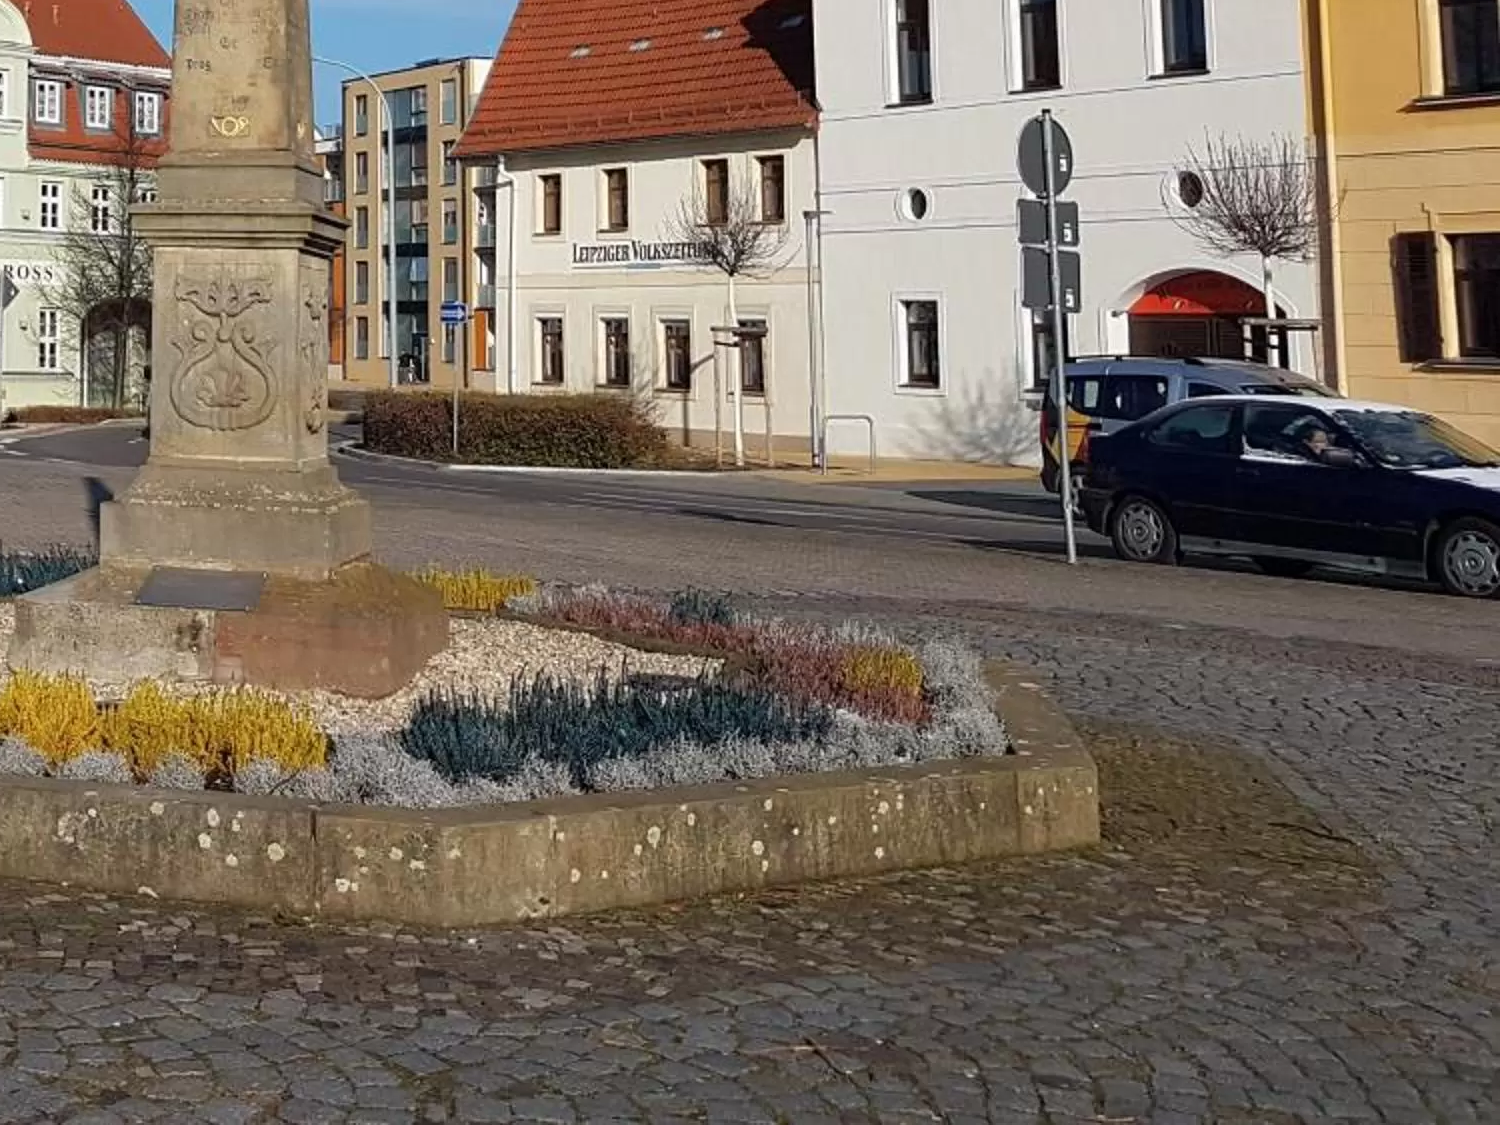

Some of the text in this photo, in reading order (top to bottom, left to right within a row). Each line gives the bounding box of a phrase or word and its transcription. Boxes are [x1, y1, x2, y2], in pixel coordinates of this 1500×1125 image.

[572, 240, 719, 264] LEIPZIGER VOLKSZEITUN
[3, 263, 54, 281] ROSS
